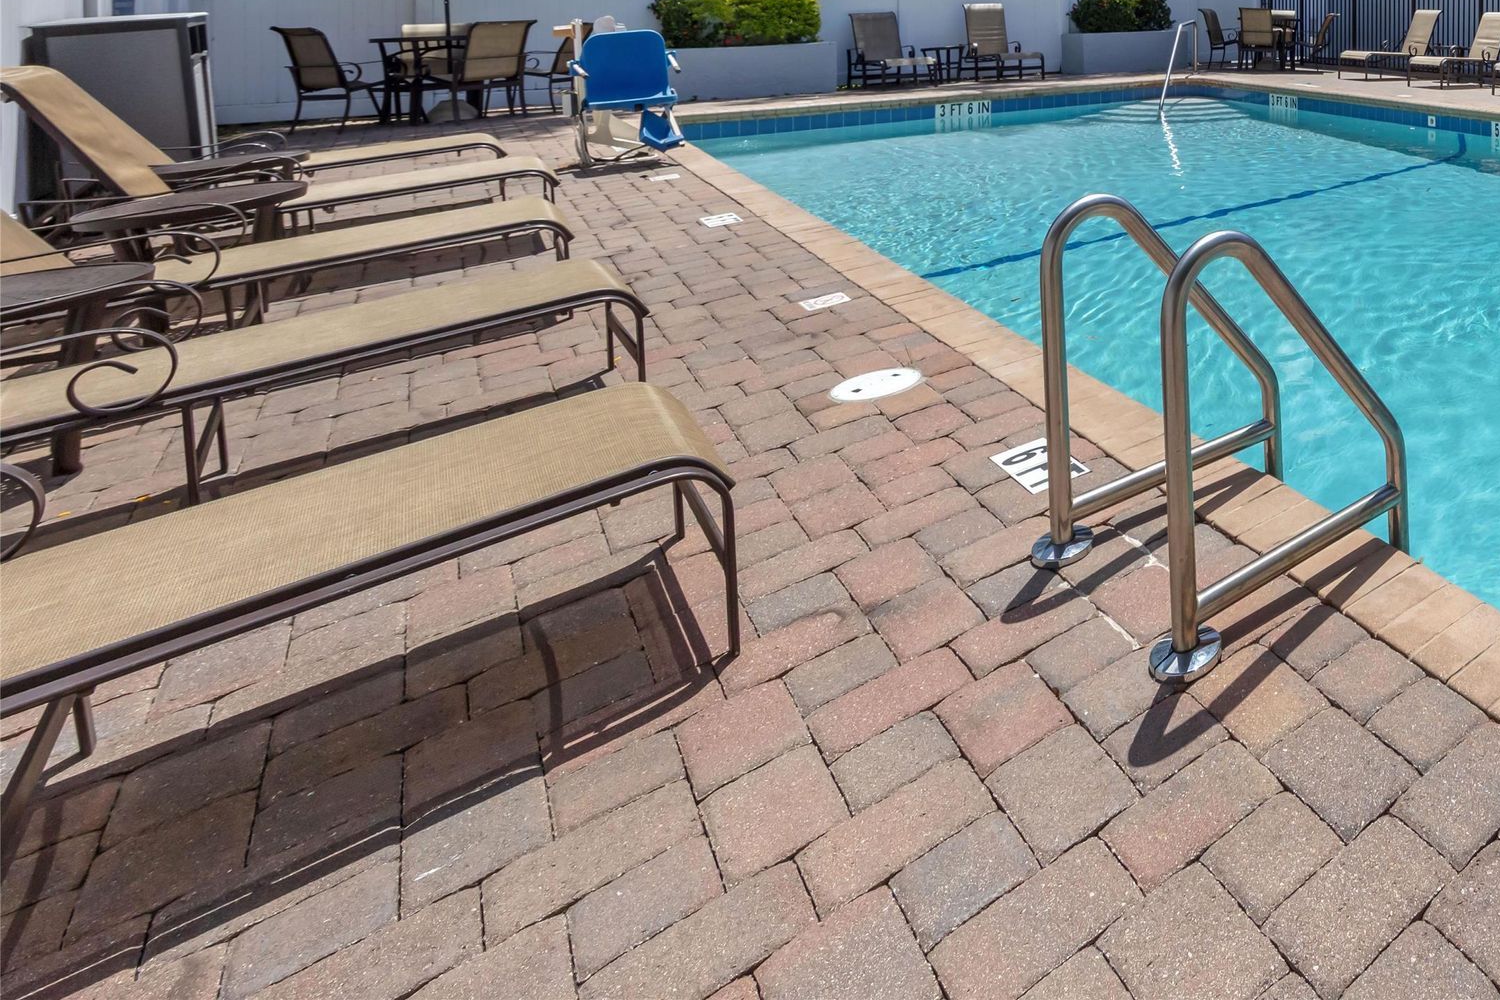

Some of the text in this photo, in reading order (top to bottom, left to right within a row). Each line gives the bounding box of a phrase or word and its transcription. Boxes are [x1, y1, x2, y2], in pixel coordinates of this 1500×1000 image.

[1276, 96, 1283, 106] FT
[940, 102, 990, 117] 3 FT 6 IN
[1495, 123, 1500, 137] 5
[1001, 445, 1048, 467] 6
